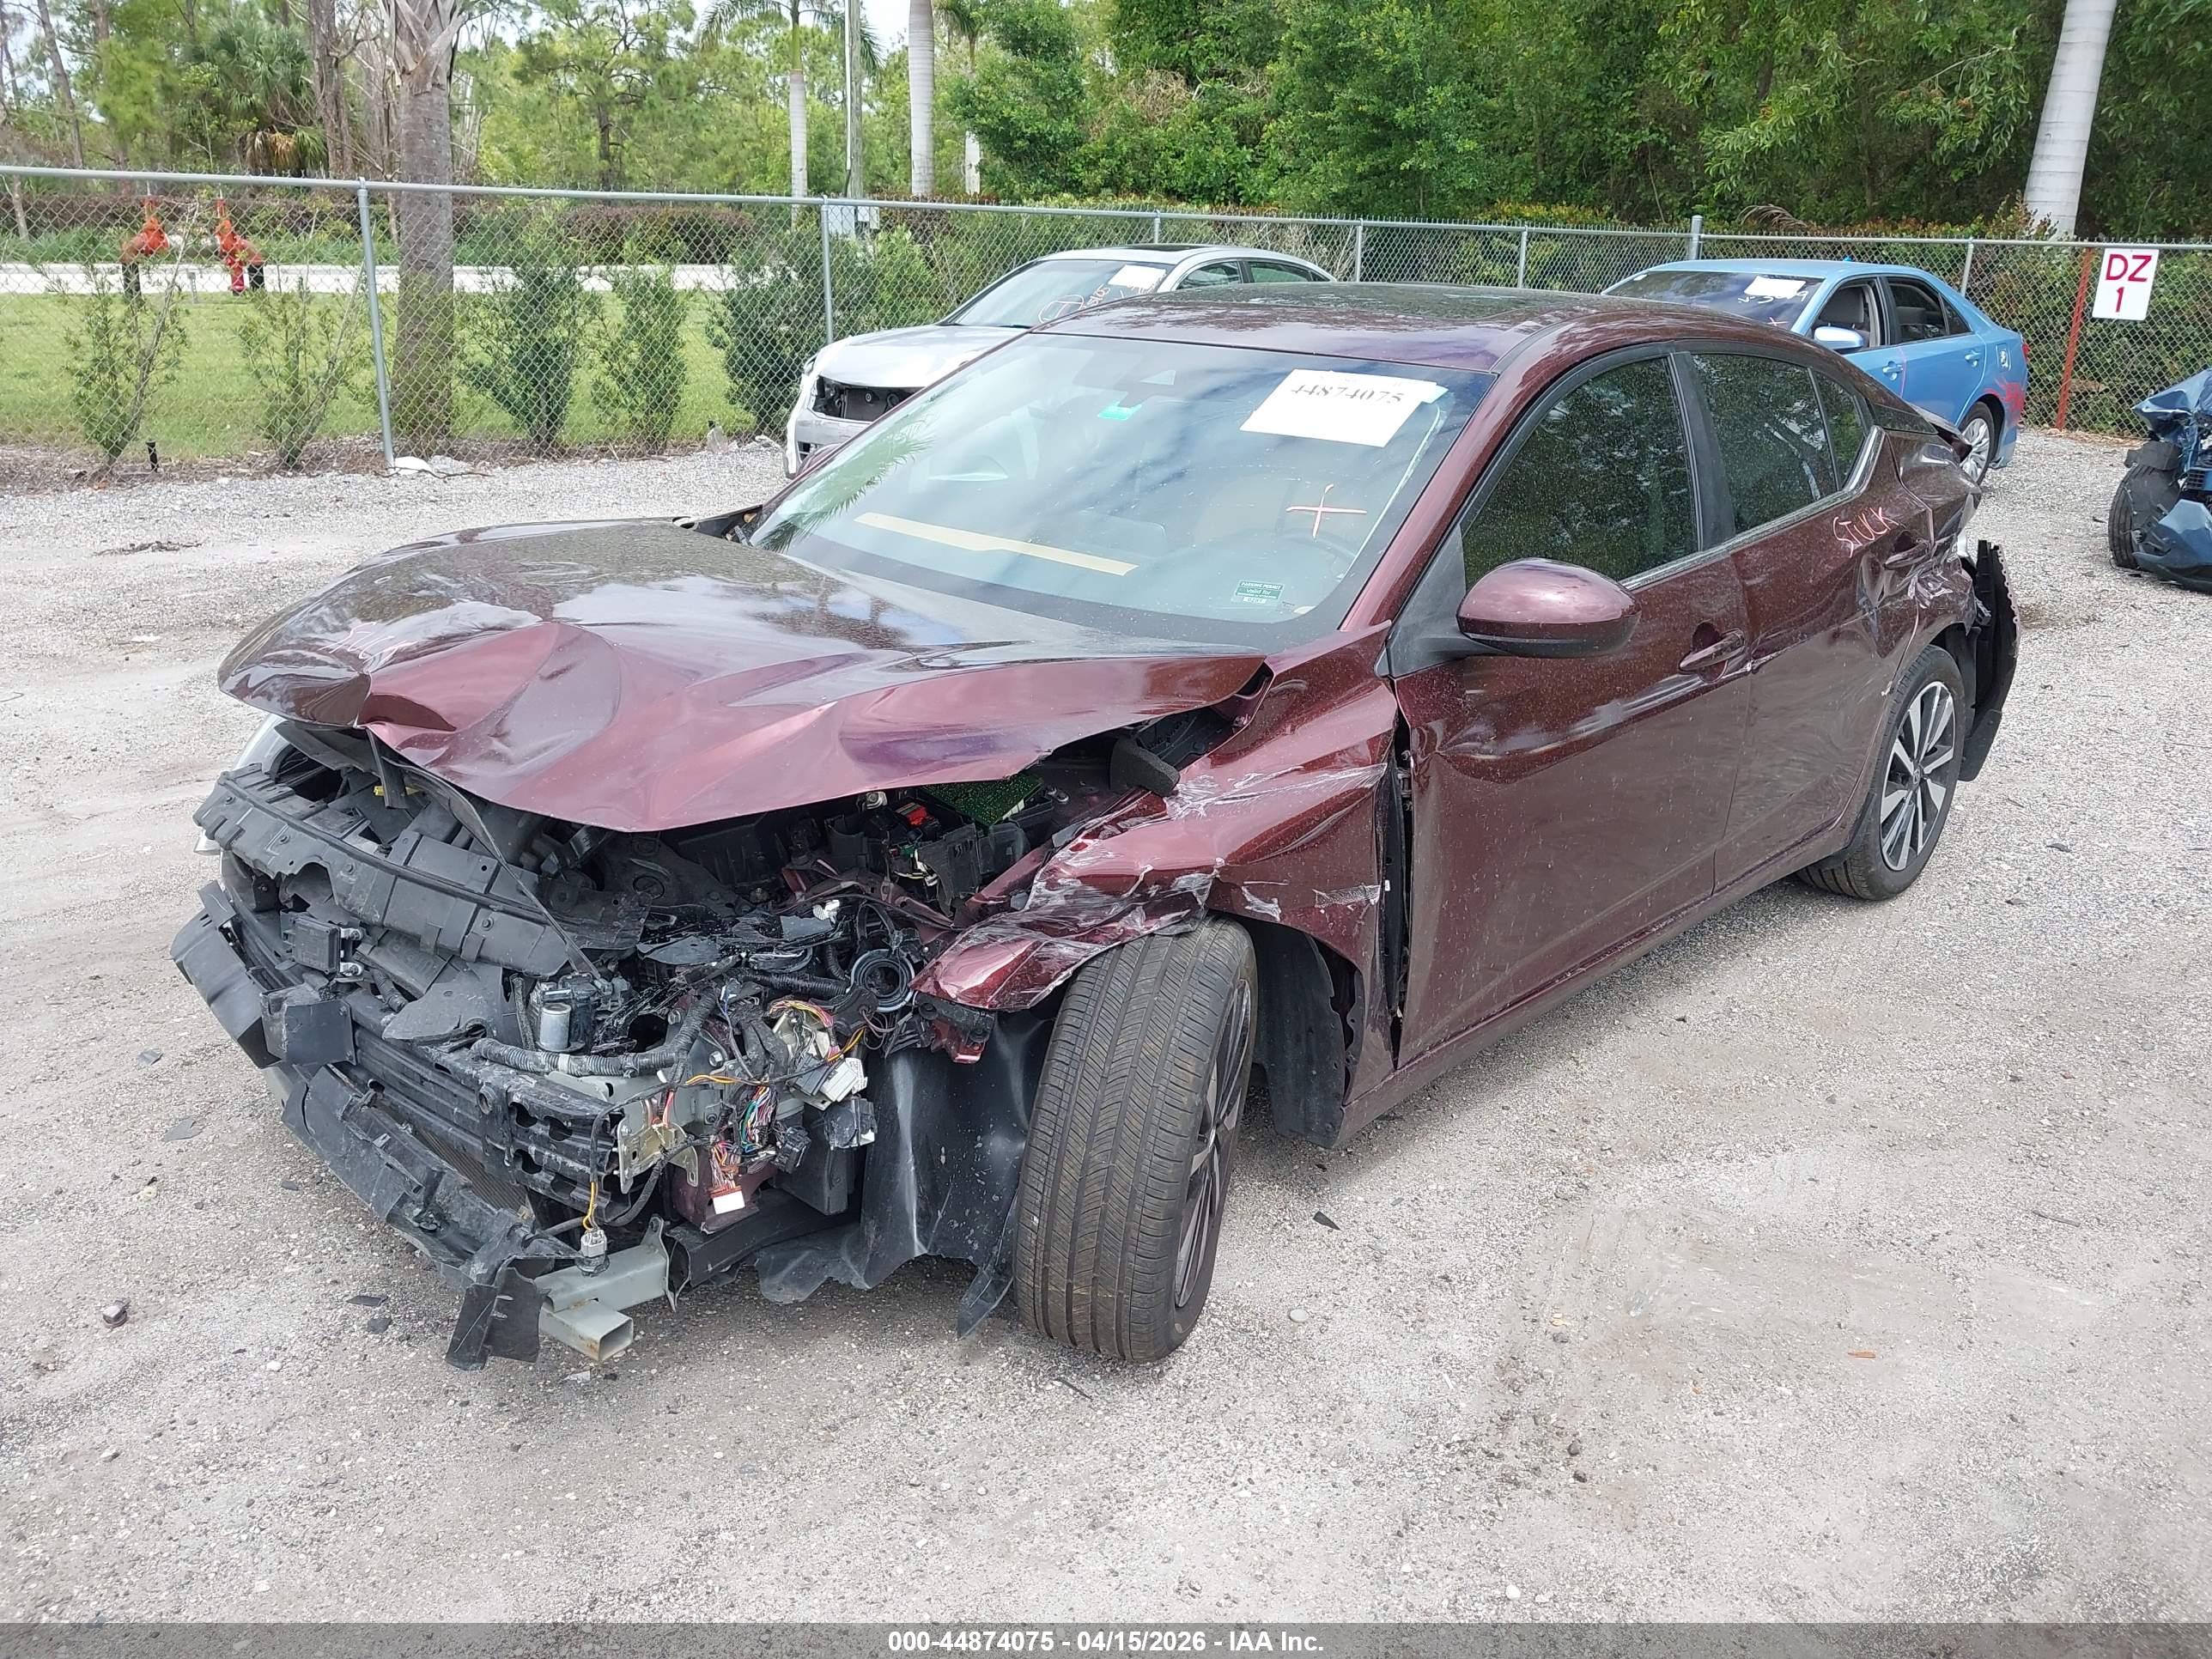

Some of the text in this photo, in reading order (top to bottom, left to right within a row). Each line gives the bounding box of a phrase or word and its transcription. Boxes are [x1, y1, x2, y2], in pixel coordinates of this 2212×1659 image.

[2106, 253, 2152, 282] DZ
[2116, 286, 2124, 313] 1
[1291, 384, 1405, 404] 44874075
[1832, 507, 1900, 558] STUCK
